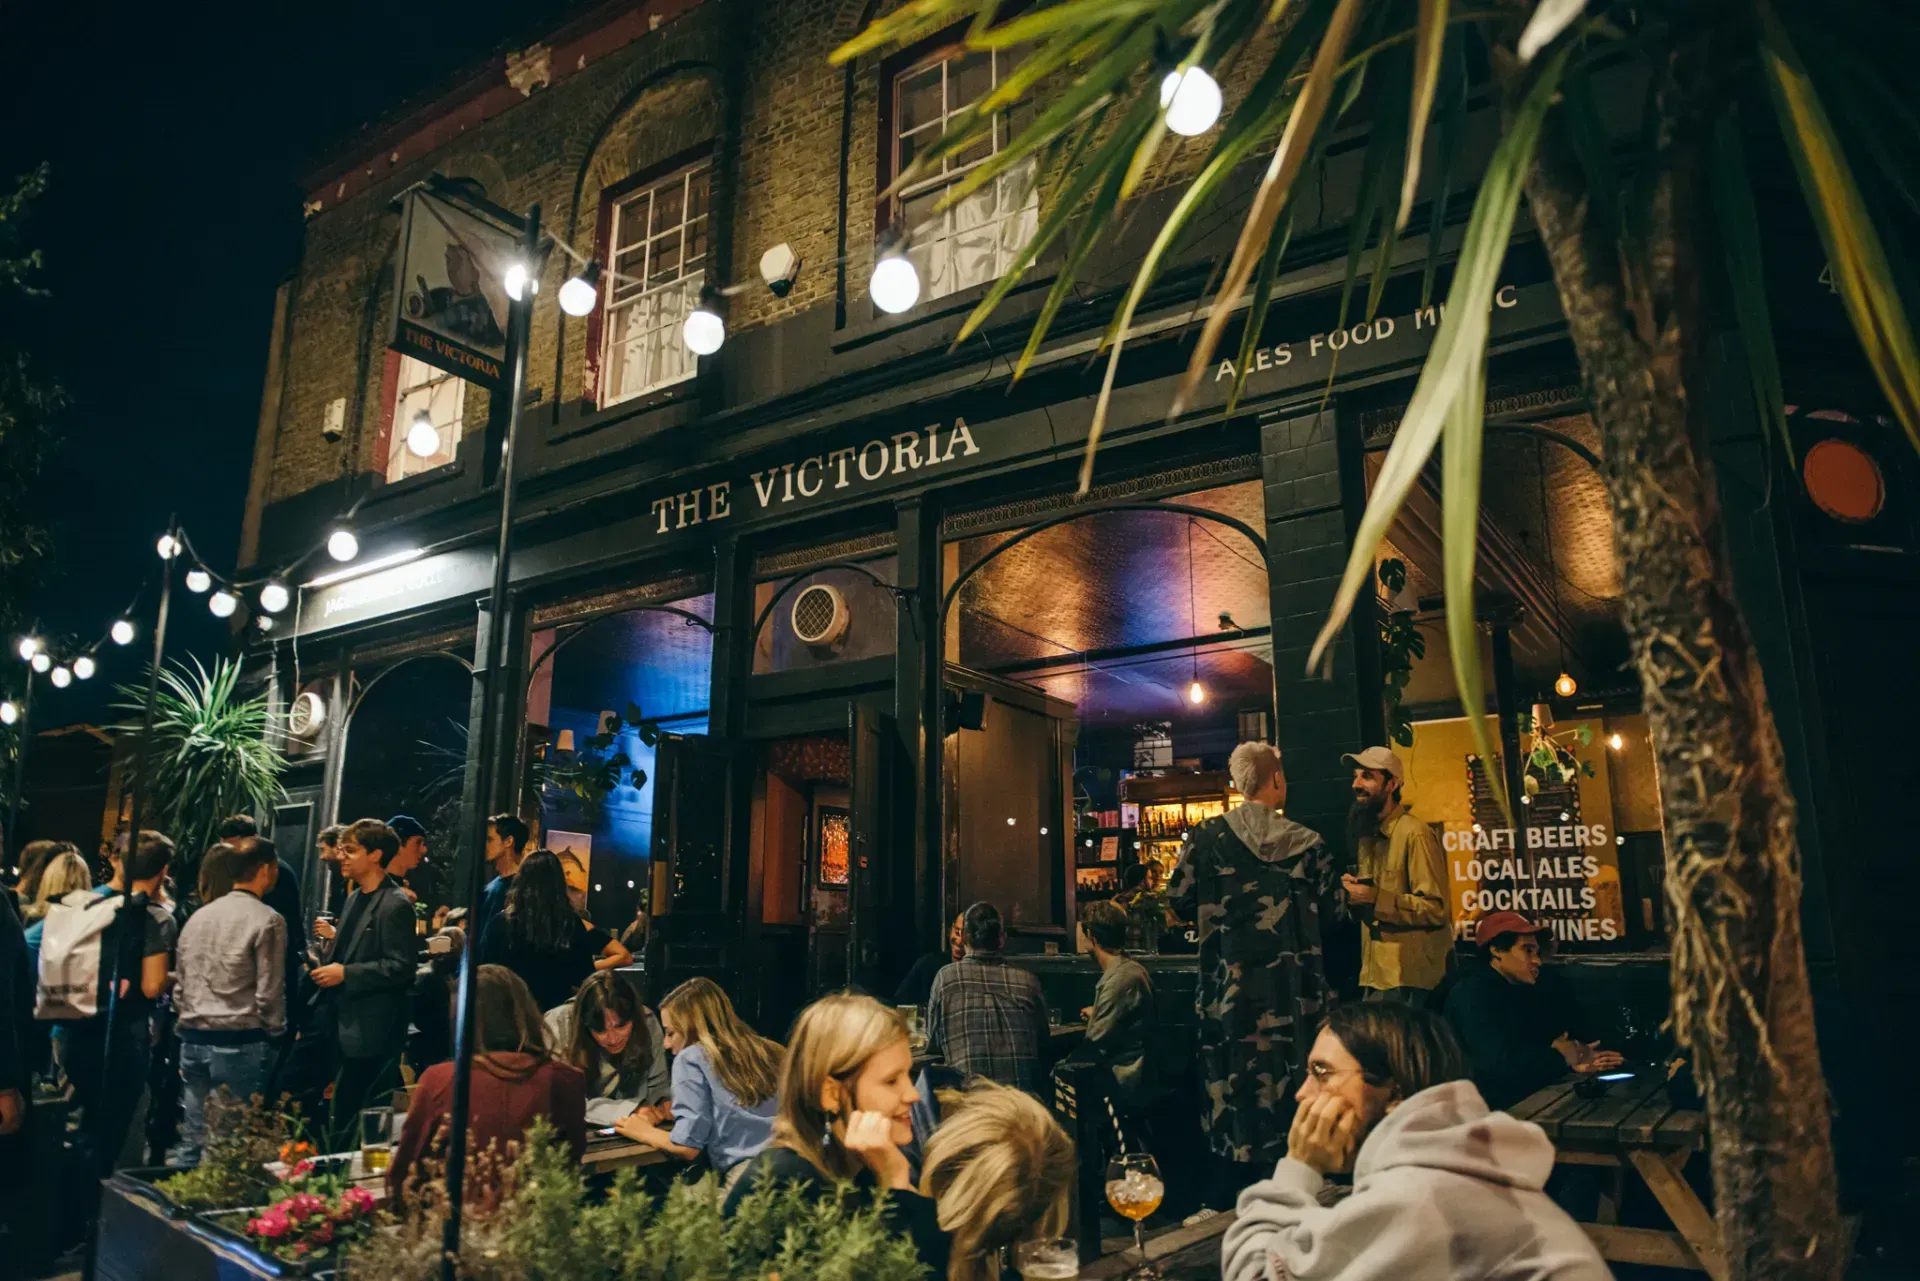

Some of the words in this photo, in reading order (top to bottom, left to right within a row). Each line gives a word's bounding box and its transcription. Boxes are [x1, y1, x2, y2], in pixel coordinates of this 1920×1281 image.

[406, 328, 433, 350] THE
[436, 341, 500, 379] VICTORIA
[1309, 317, 1395, 357] FOOD
[651, 480, 732, 535] THE
[750, 416, 980, 507] VICTORIA
[1442, 828, 1518, 852] CRAFT
[1527, 825, 1608, 849] BEERS
[1454, 858, 1530, 882] LOCAL
[1538, 856, 1600, 879] ALES
[1462, 887, 1597, 911] COCKTAILS
